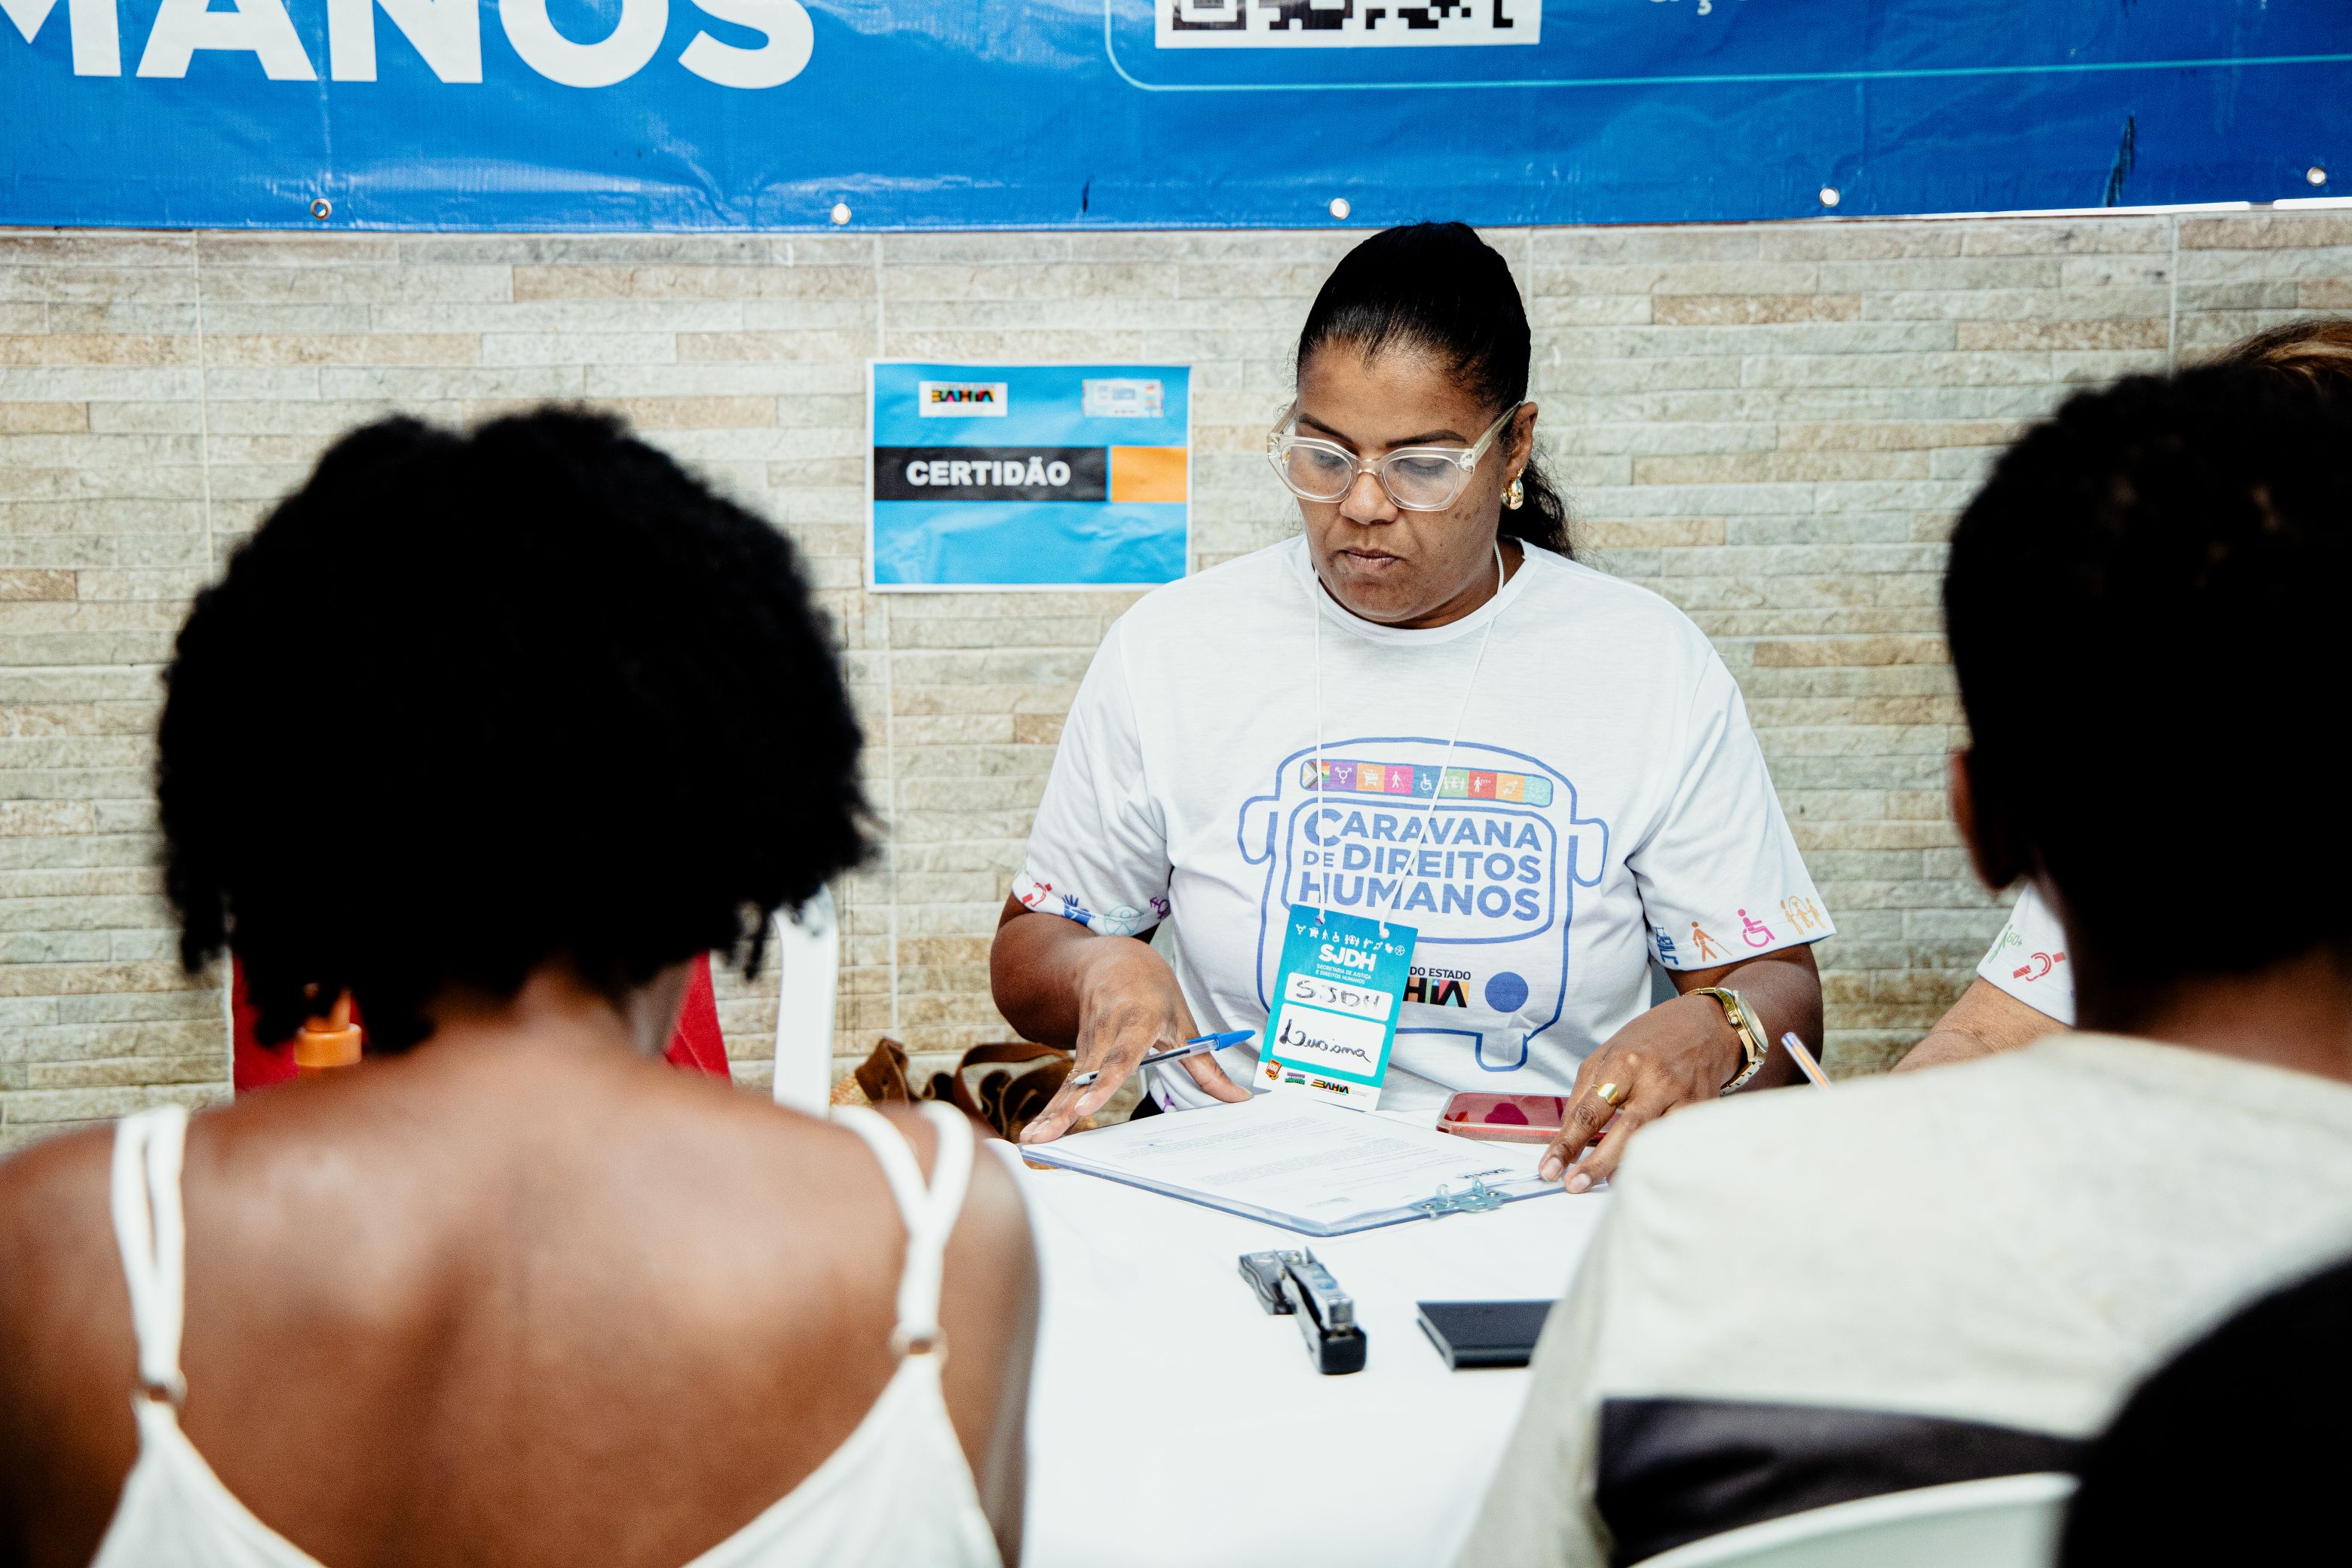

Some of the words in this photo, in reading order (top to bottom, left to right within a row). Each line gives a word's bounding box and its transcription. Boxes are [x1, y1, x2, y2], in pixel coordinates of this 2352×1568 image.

[931, 389, 994, 403] BAHIA
[906, 456, 1071, 487] CERTIDÃO
[1304, 808, 1542, 852] CARAVANA
[1303, 850, 1335, 868] DE
[1343, 843, 1542, 884] DIREITOS
[1298, 871, 1541, 921] HUMANOS
[1318, 943, 1377, 972] SJDH
[1317, 963, 1345, 975] SECRETARIA
[1320, 970, 1341, 979] DIREITOS
[1342, 975, 1365, 985] HUMANOS
[1410, 966, 1426, 977] DO
[1429, 967, 1472, 981] ESTADO
[1311, 1079, 1349, 1095] BAHIA
